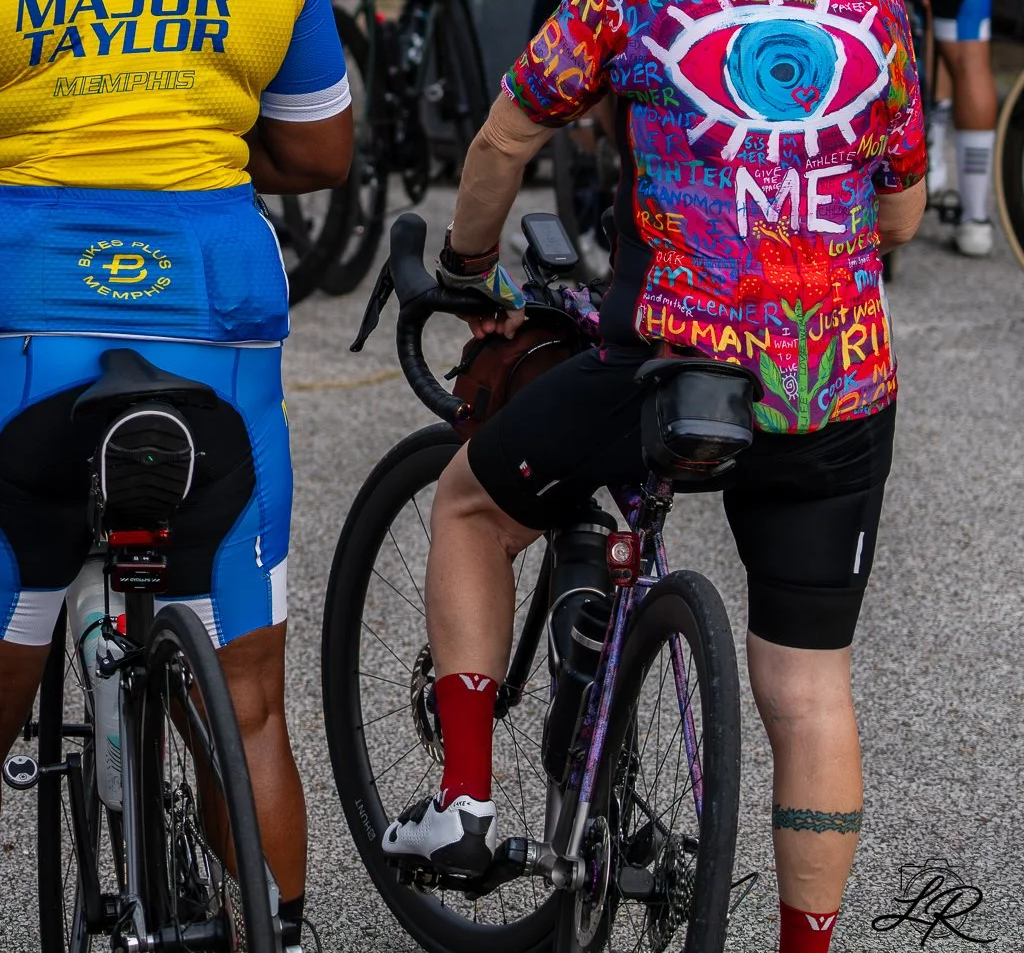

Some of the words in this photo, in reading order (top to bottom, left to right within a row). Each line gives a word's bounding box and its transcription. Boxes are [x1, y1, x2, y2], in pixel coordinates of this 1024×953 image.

[23, 18, 230, 66] TAYLOR
[53, 70, 196, 96] MEMPHIS
[806, 151, 857, 169] ATHLETE
[734, 162, 853, 240] ME
[78, 239, 124, 268] BIKES
[131, 241, 172, 270] PLUS
[83, 275, 171, 300] MEMPHIS
[647, 303, 771, 360] HUMAN
[773, 338, 799, 350] WANT
